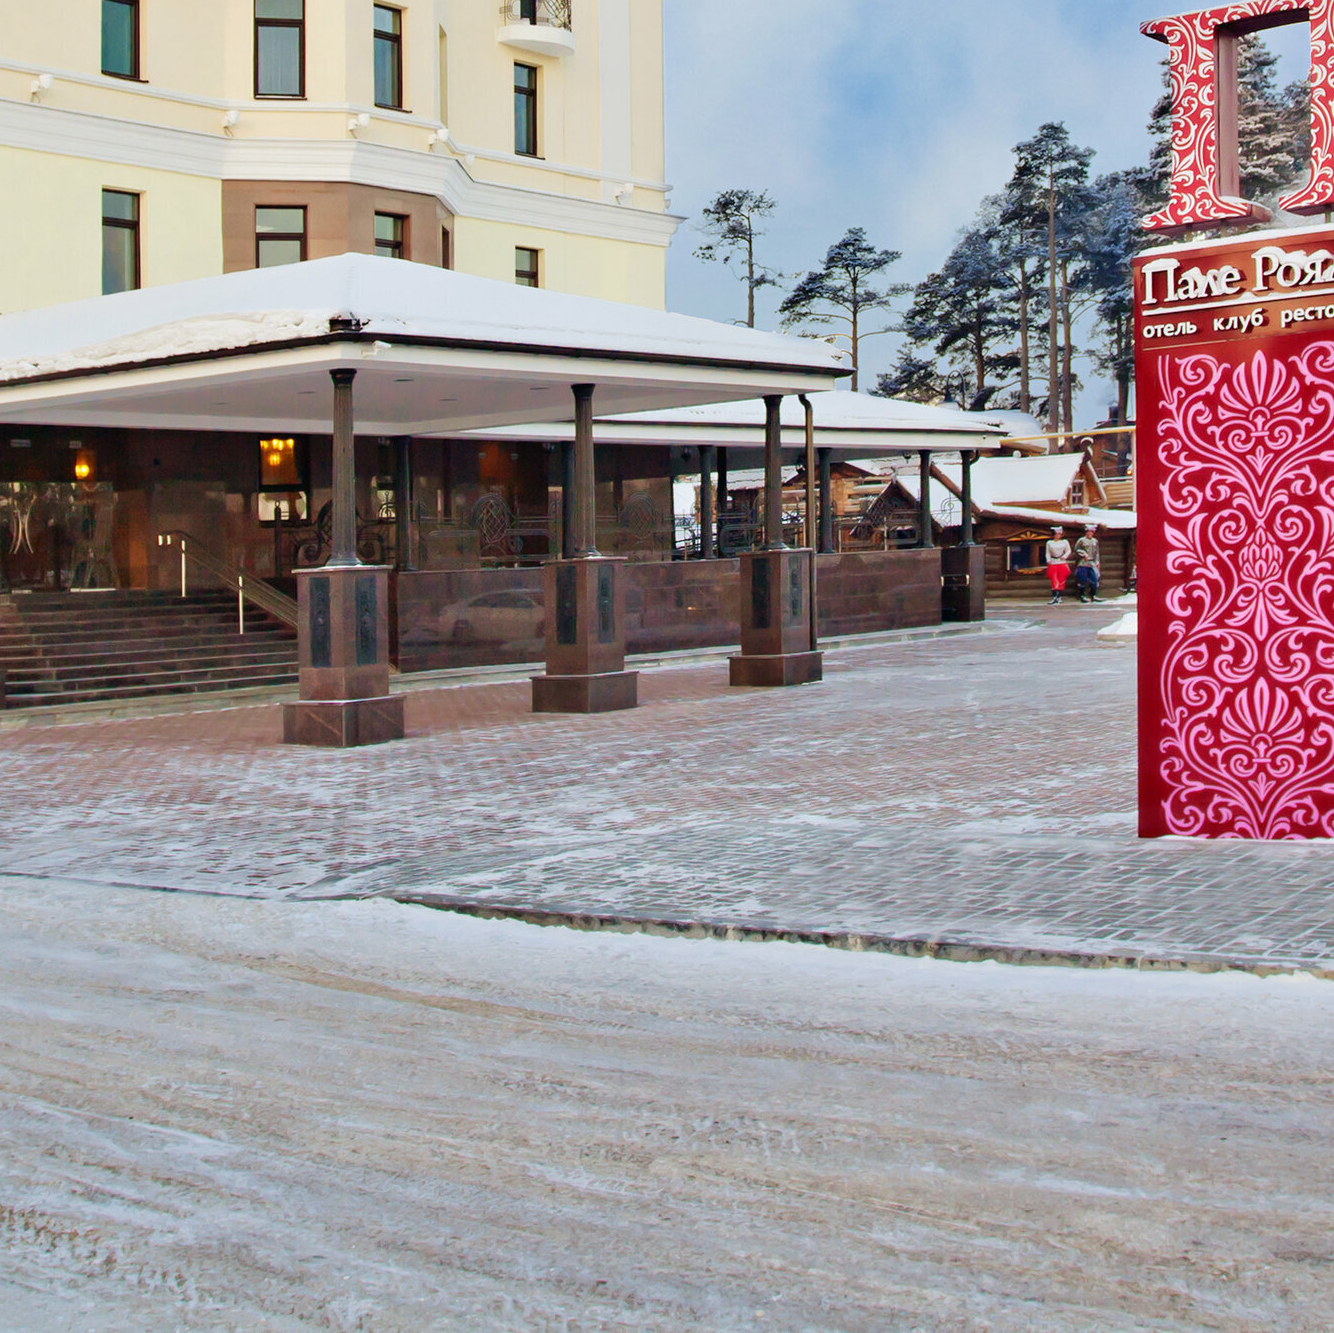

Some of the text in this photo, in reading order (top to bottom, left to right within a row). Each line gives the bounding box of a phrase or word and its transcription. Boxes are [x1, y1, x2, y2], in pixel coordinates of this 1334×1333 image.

[1141, 258, 1241, 304] Пале
[1142, 320, 1198, 339] отель
[1213, 307, 1265, 333] клуб
